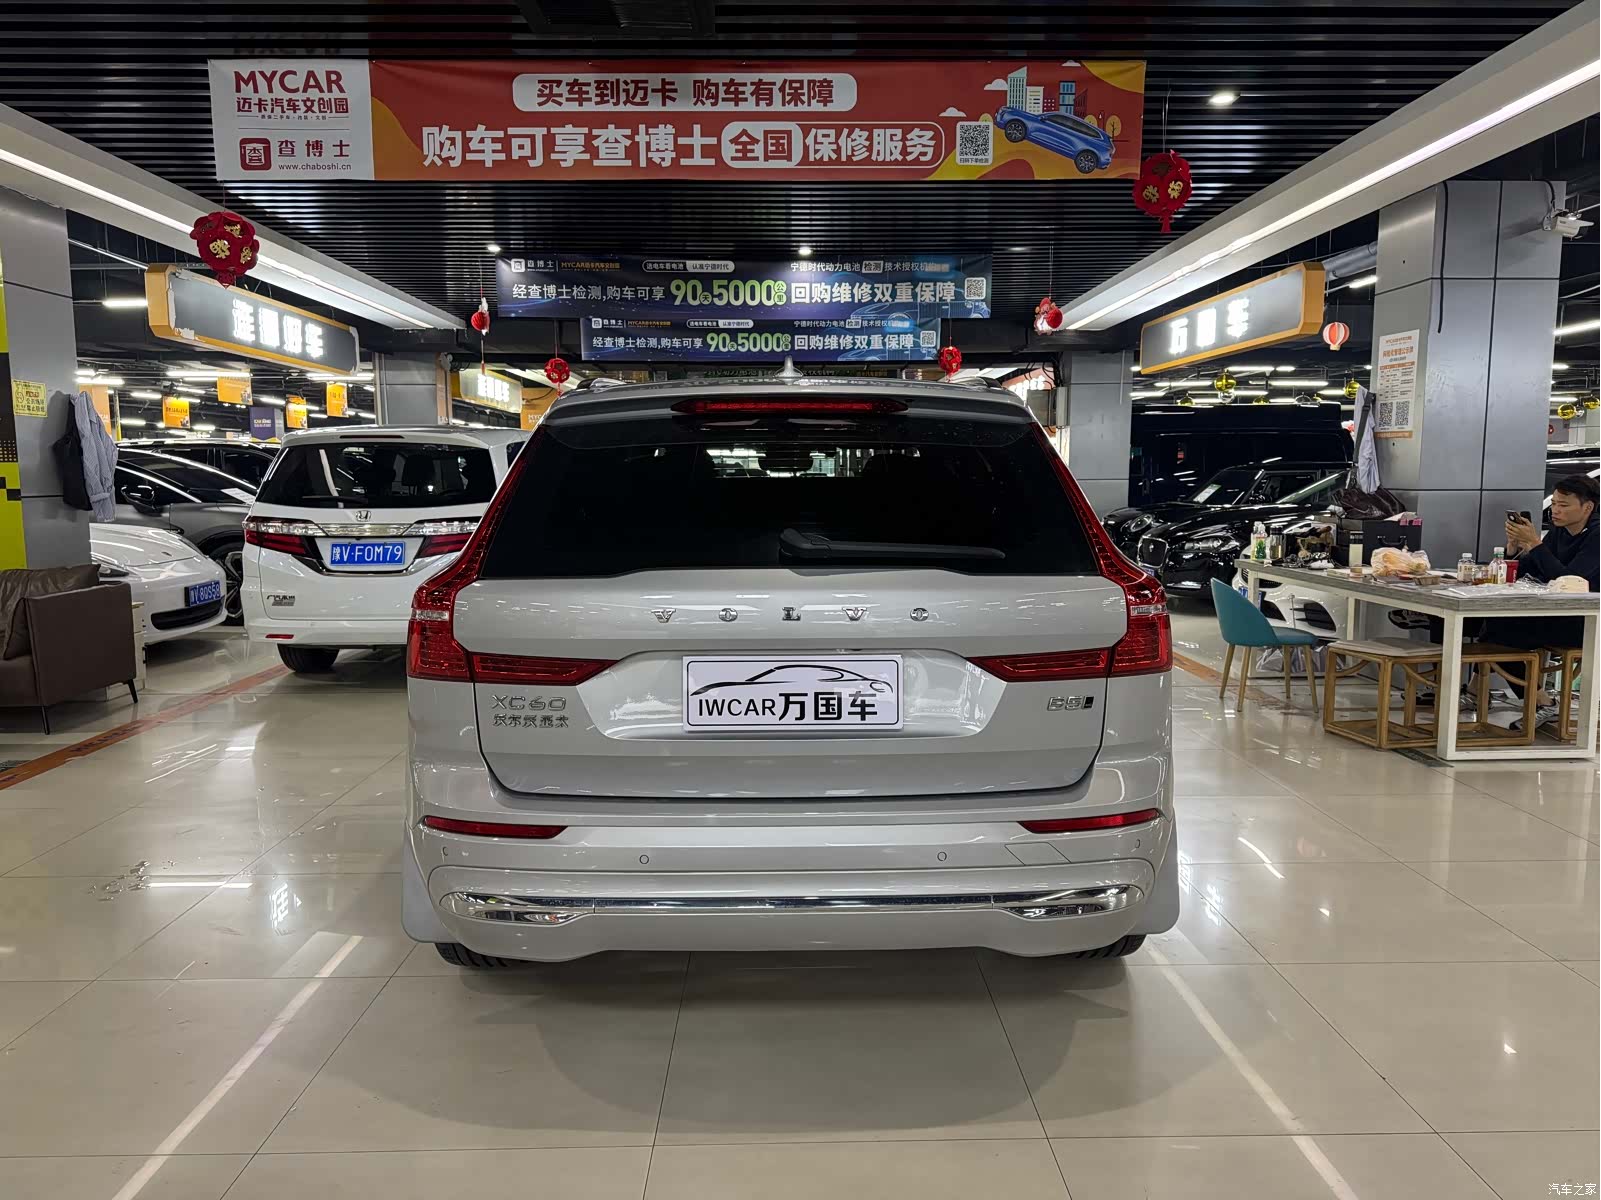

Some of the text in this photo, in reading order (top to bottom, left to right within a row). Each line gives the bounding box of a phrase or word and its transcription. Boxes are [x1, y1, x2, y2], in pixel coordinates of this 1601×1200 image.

[233, 69, 346, 94] MYCAR
[536, 77, 834, 107] 买车到迈卡 购车有保障
[236, 97, 349, 114] 迈卡汽车文创园
[278, 139, 350, 159] 查博士
[421, 124, 936, 168] 购车可享查博士 全国 保修服务
[278, 163, 352, 172] www.chaboshi.cn
[791, 262, 860, 272] 宁德时代动力电池
[512, 283, 665, 301] 经查博士检测,购车可享
[791, 282, 956, 304] 回购维修双重保障
[592, 336, 703, 349] 经查博士检测,购车可享
[794, 335, 914, 351] 回购维修双重保障
[651, 607, 930, 623] VOLVO
[492, 695, 567, 711] XC60
